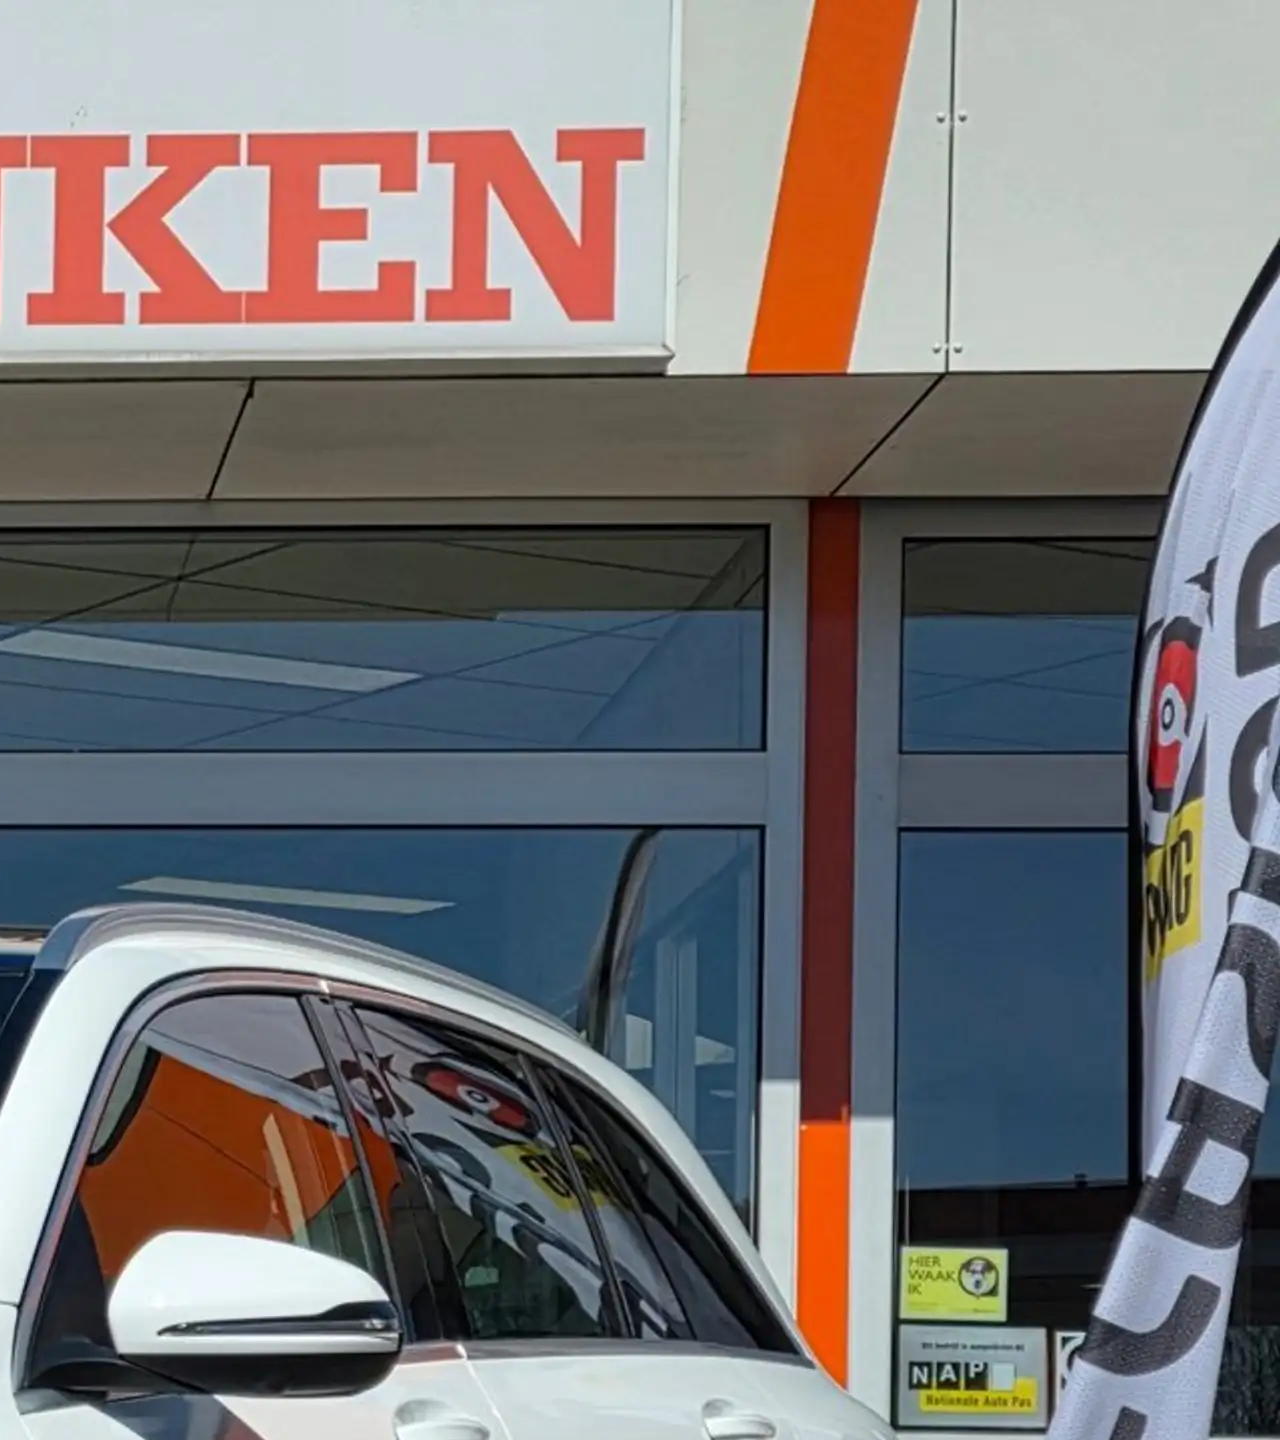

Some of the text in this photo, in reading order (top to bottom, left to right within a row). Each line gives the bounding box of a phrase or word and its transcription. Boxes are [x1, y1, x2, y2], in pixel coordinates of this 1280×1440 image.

[909, 1256, 941, 1267] HIER
[909, 1270, 956, 1283] WAAK
[908, 1284, 922, 1295] IK
[926, 1393, 1032, 1409] Nationale Auto Pas
